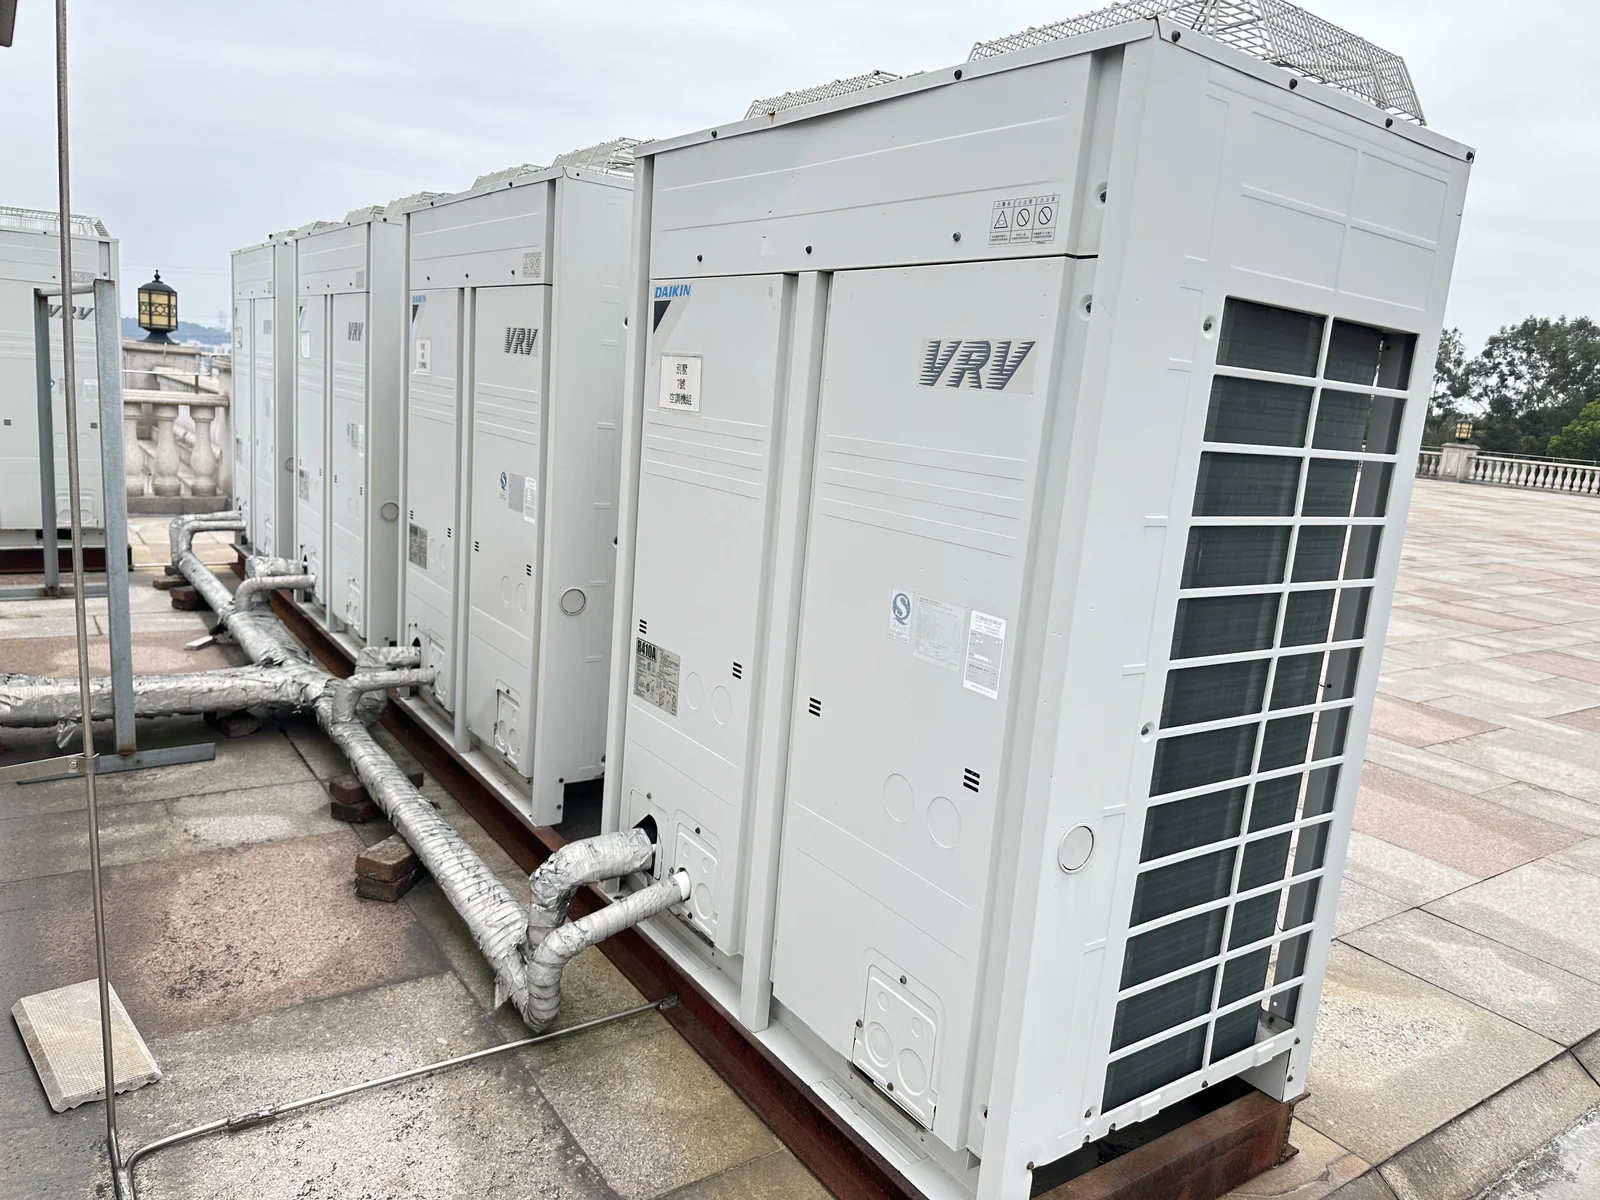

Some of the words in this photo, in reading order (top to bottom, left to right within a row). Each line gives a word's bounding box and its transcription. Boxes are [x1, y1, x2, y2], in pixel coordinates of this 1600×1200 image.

[654, 284, 691, 299] DAIKIN
[347, 322, 364, 341] VRV
[504, 327, 538, 356] VRV
[918, 340, 1037, 391] VRV
[637, 640, 657, 661] R410A
